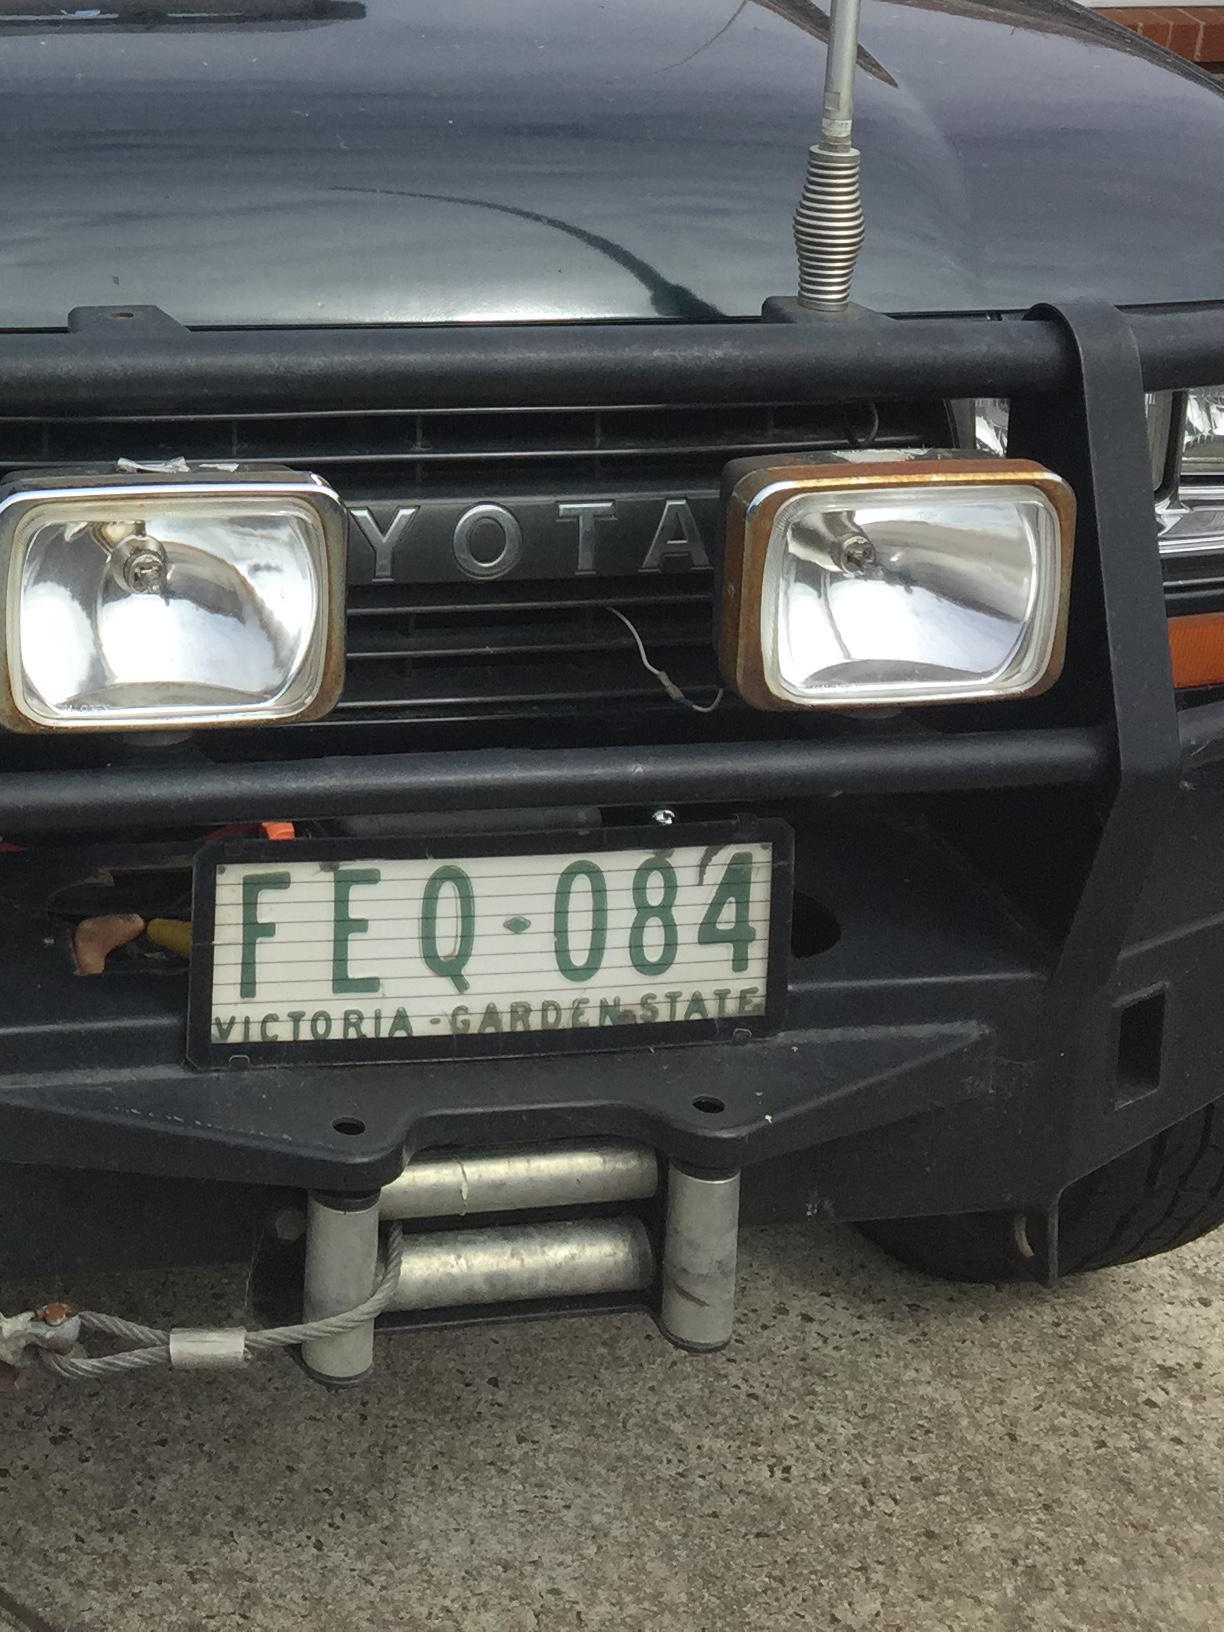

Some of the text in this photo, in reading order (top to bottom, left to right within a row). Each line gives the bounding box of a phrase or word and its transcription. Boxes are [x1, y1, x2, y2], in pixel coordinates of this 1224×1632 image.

[349, 499, 714, 581] YOTA
[214, 1007, 413, 1043] VICTORIA
[450, 1001, 622, 1035] GARDEN
[639, 986, 760, 1022] STATE
